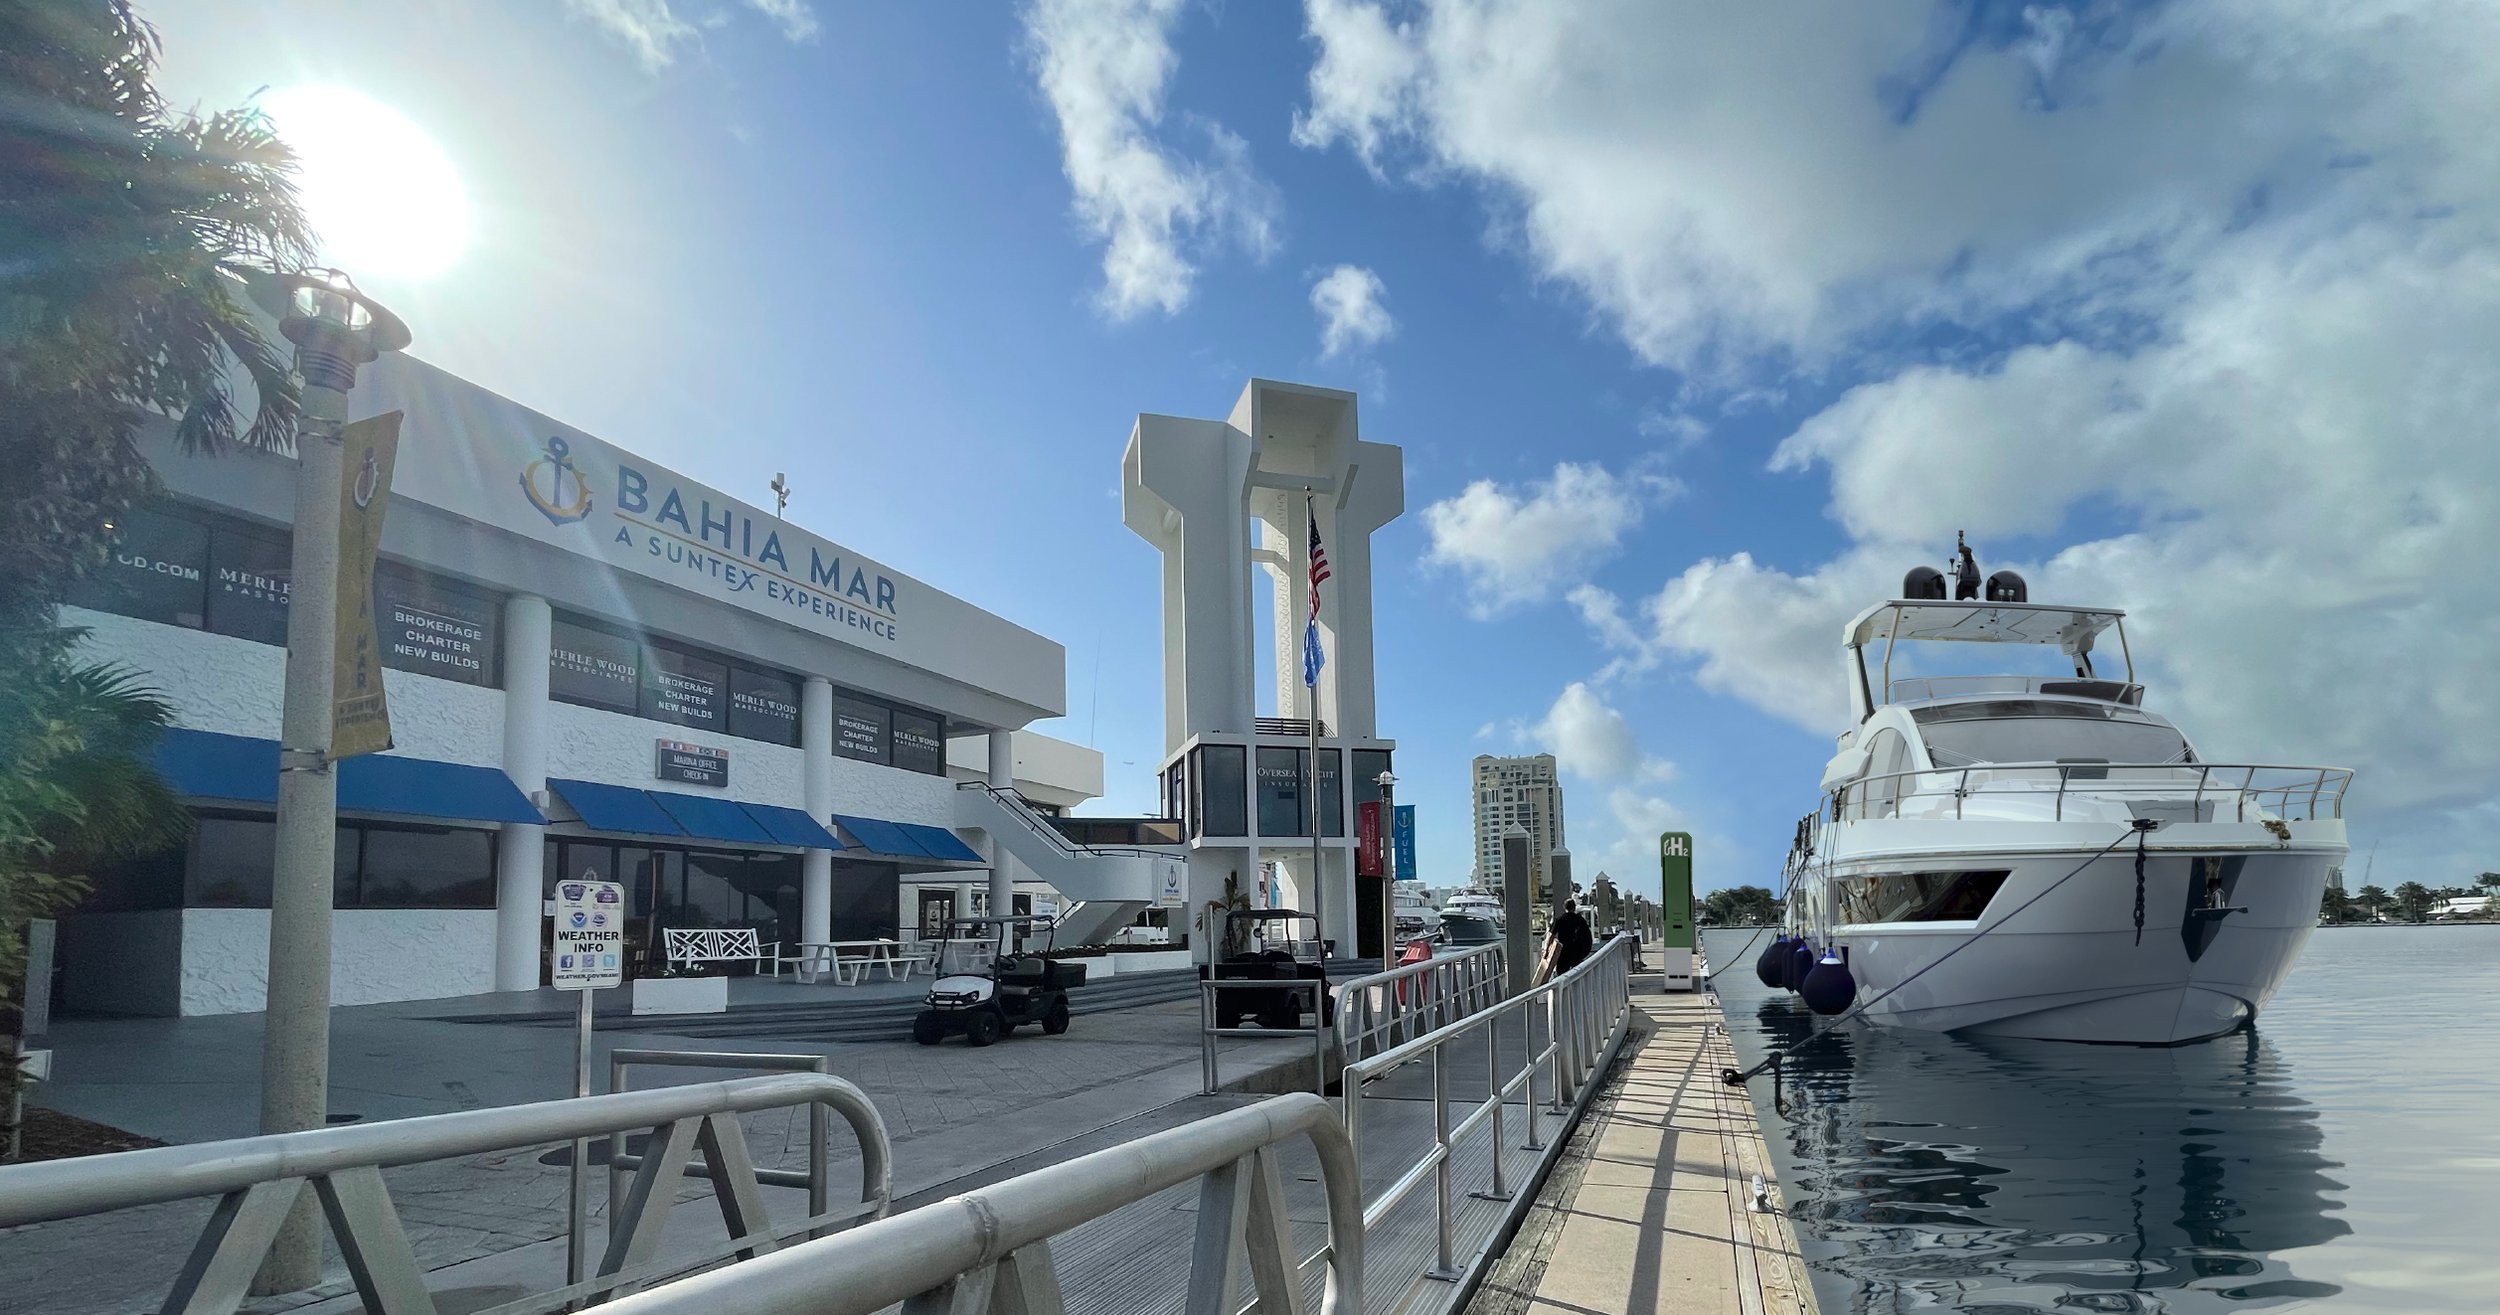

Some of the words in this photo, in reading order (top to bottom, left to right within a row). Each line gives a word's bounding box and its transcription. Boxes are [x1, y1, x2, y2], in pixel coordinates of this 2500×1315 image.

[618, 464, 788, 573] BAHIA
[810, 547, 897, 615] MAR
[615, 525, 633, 547] A
[648, 536, 761, 592] SUNTEX
[767, 580, 897, 641] EXPERIENCE
[395, 611, 482, 640] BROKERAGE
[405, 630, 471, 653] CHARTER
[394, 643, 427, 658] NEW
[431, 651, 480, 670] BUILDS
[549, 648, 592, 666] MERLE
[596, 659, 636, 676] WOOD
[560, 660, 633, 683] ASSOCIATES
[658, 675, 715, 695] BROKERAGE
[665, 690, 707, 706] CHARTER
[733, 692, 765, 707] MERLE
[767, 700, 797, 714] WOOD
[658, 701, 680, 713] NEW
[681, 705, 713, 719] BUILDS
[741, 704, 795, 720] ASSOCIATES
[839, 718, 879, 734] BROKERAGE
[843, 730, 874, 742] CHARTER
[894, 730, 916, 741] MERLE
[918, 736, 940, 747] WOOD
[839, 740, 854, 749] NEW
[855, 743, 878, 754] BUILDS
[673, 755, 697, 767] MARINA
[698, 758, 718, 770] OFFICE
[1257, 767, 1297, 778] OVERSEA
[1401, 830, 1409, 864] FUEL
[558, 931, 619, 941] WEATHER
[574, 943, 604, 953] INFO
